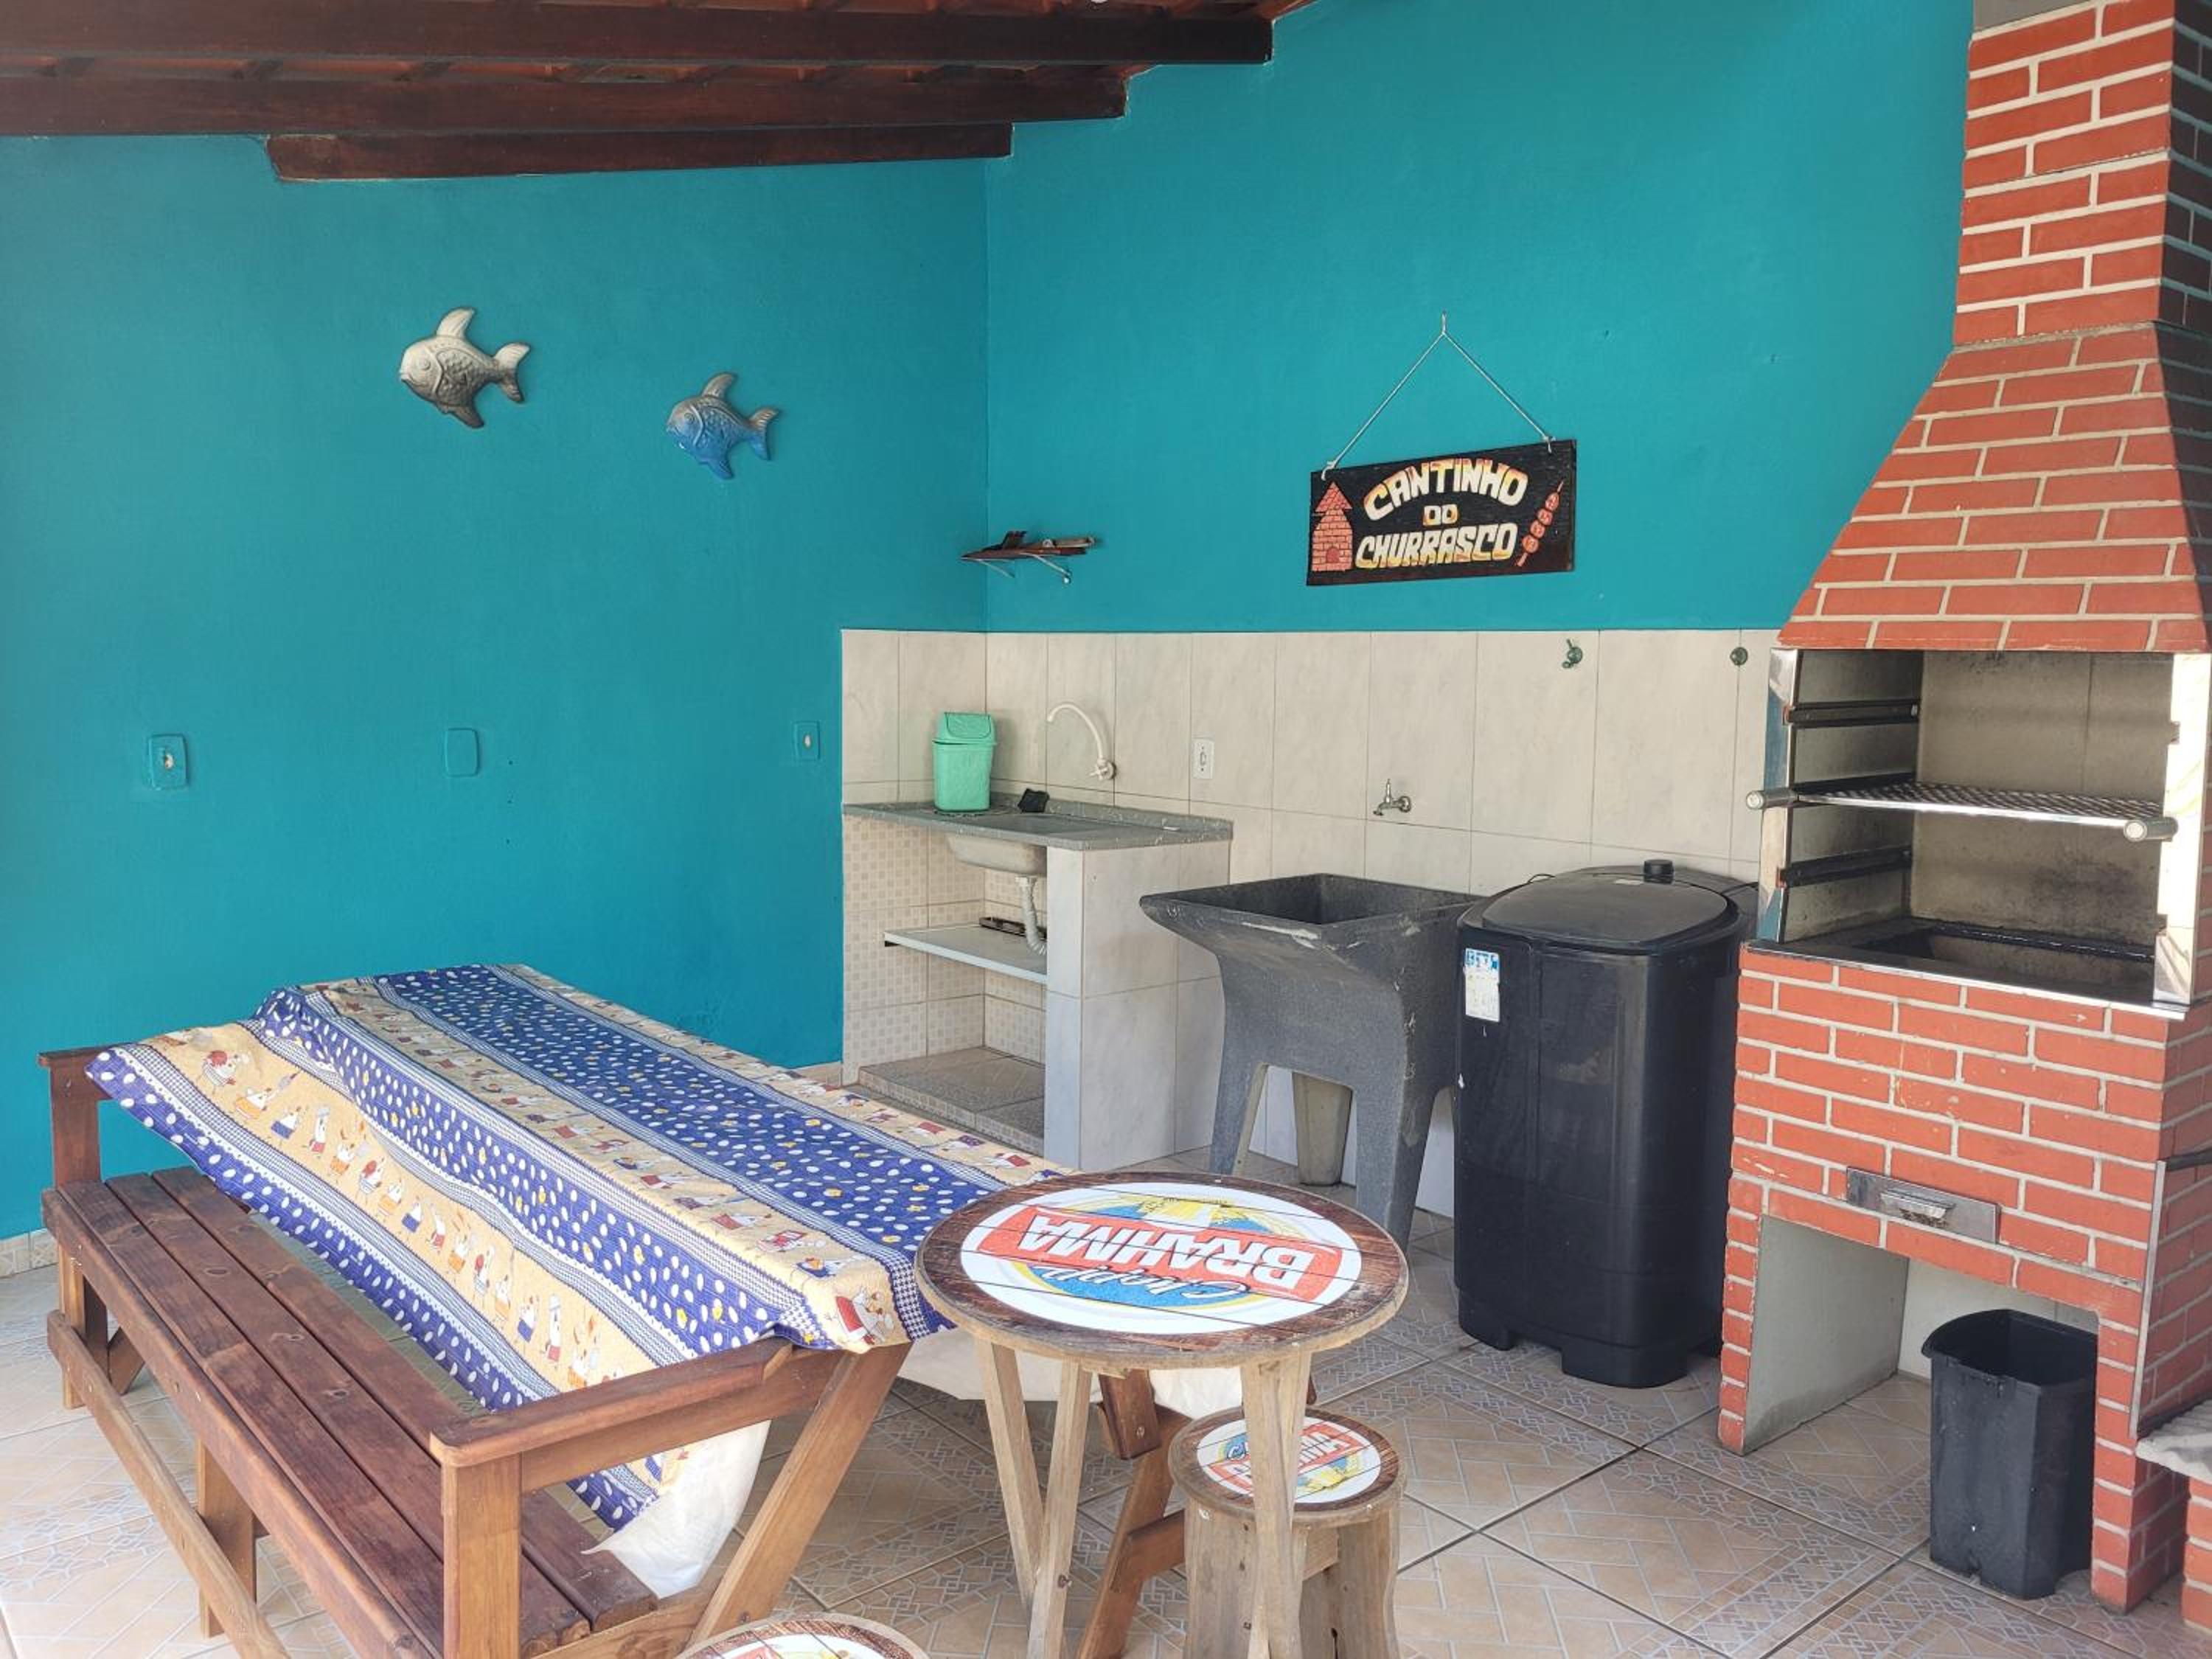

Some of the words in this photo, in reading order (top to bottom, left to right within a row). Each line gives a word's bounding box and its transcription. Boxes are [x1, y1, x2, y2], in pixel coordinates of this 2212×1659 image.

[1364, 458, 1528, 521] CANTINHO
[1423, 504, 1458, 526] DO
[1355, 523, 1518, 568] CHURRASCO
[1017, 1214, 1313, 1290] BRAHMA
[1034, 1265, 1251, 1298] Chopp
